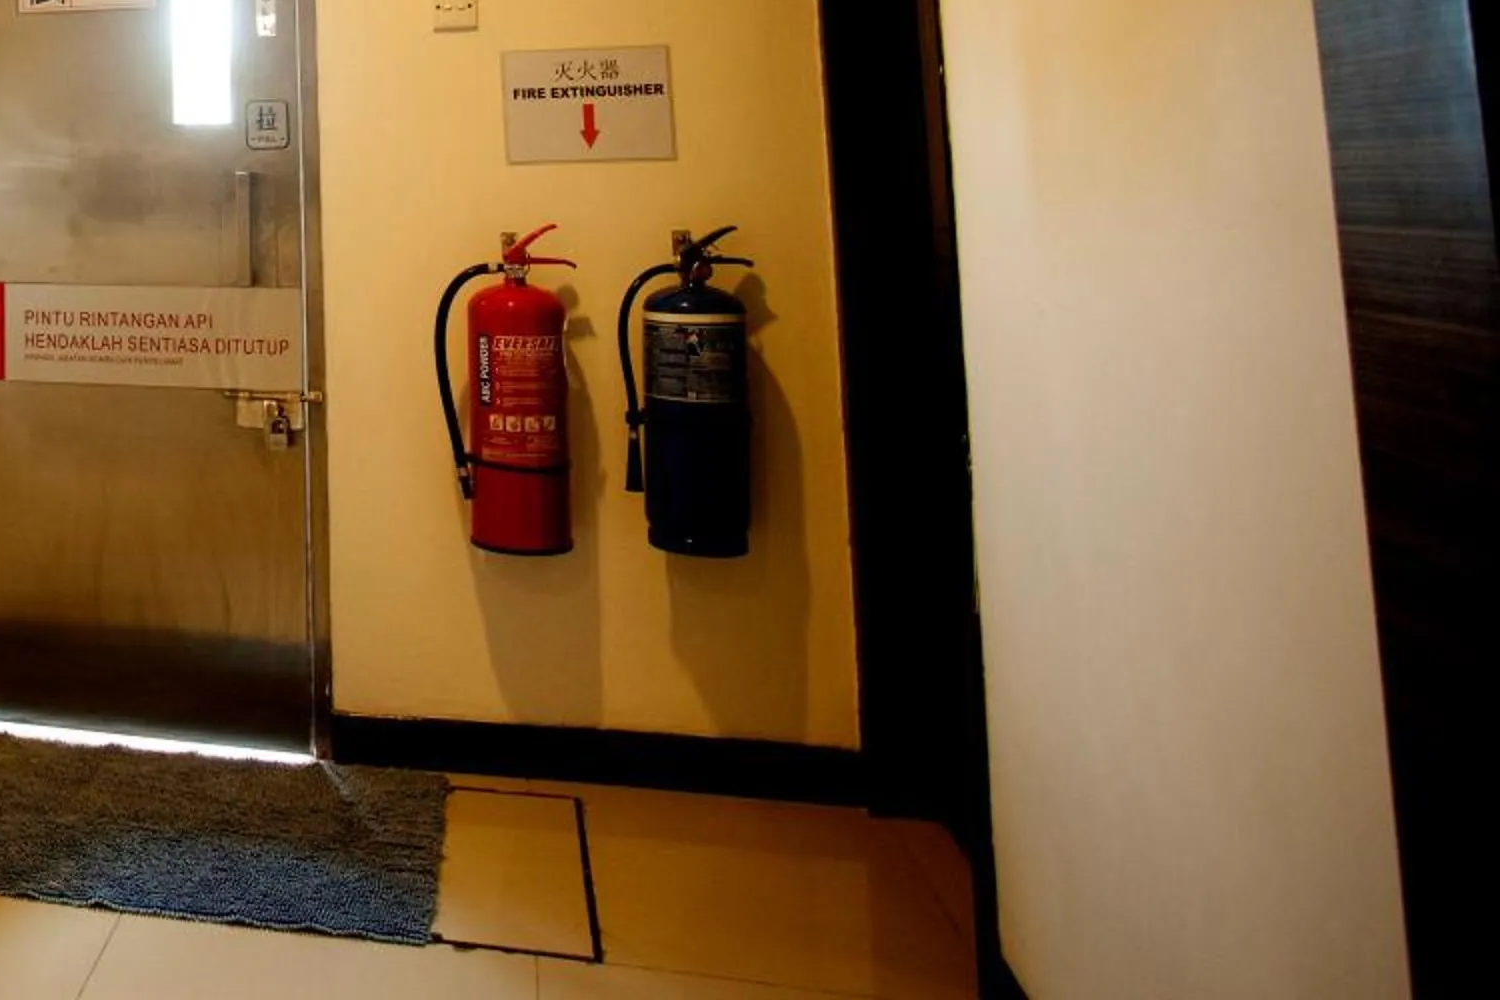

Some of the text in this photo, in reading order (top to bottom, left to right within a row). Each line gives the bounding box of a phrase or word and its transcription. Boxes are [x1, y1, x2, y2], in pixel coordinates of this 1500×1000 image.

[554, 59, 619, 81] 灭火器
[513, 83, 665, 101] FIRE EXTINGUISHER
[24, 309, 213, 329] PINTU RINTANGAN API
[25, 332, 289, 356] HENDAKLAH SENTIASA DITUTUP
[479, 336, 491, 403] ABC POWDER
